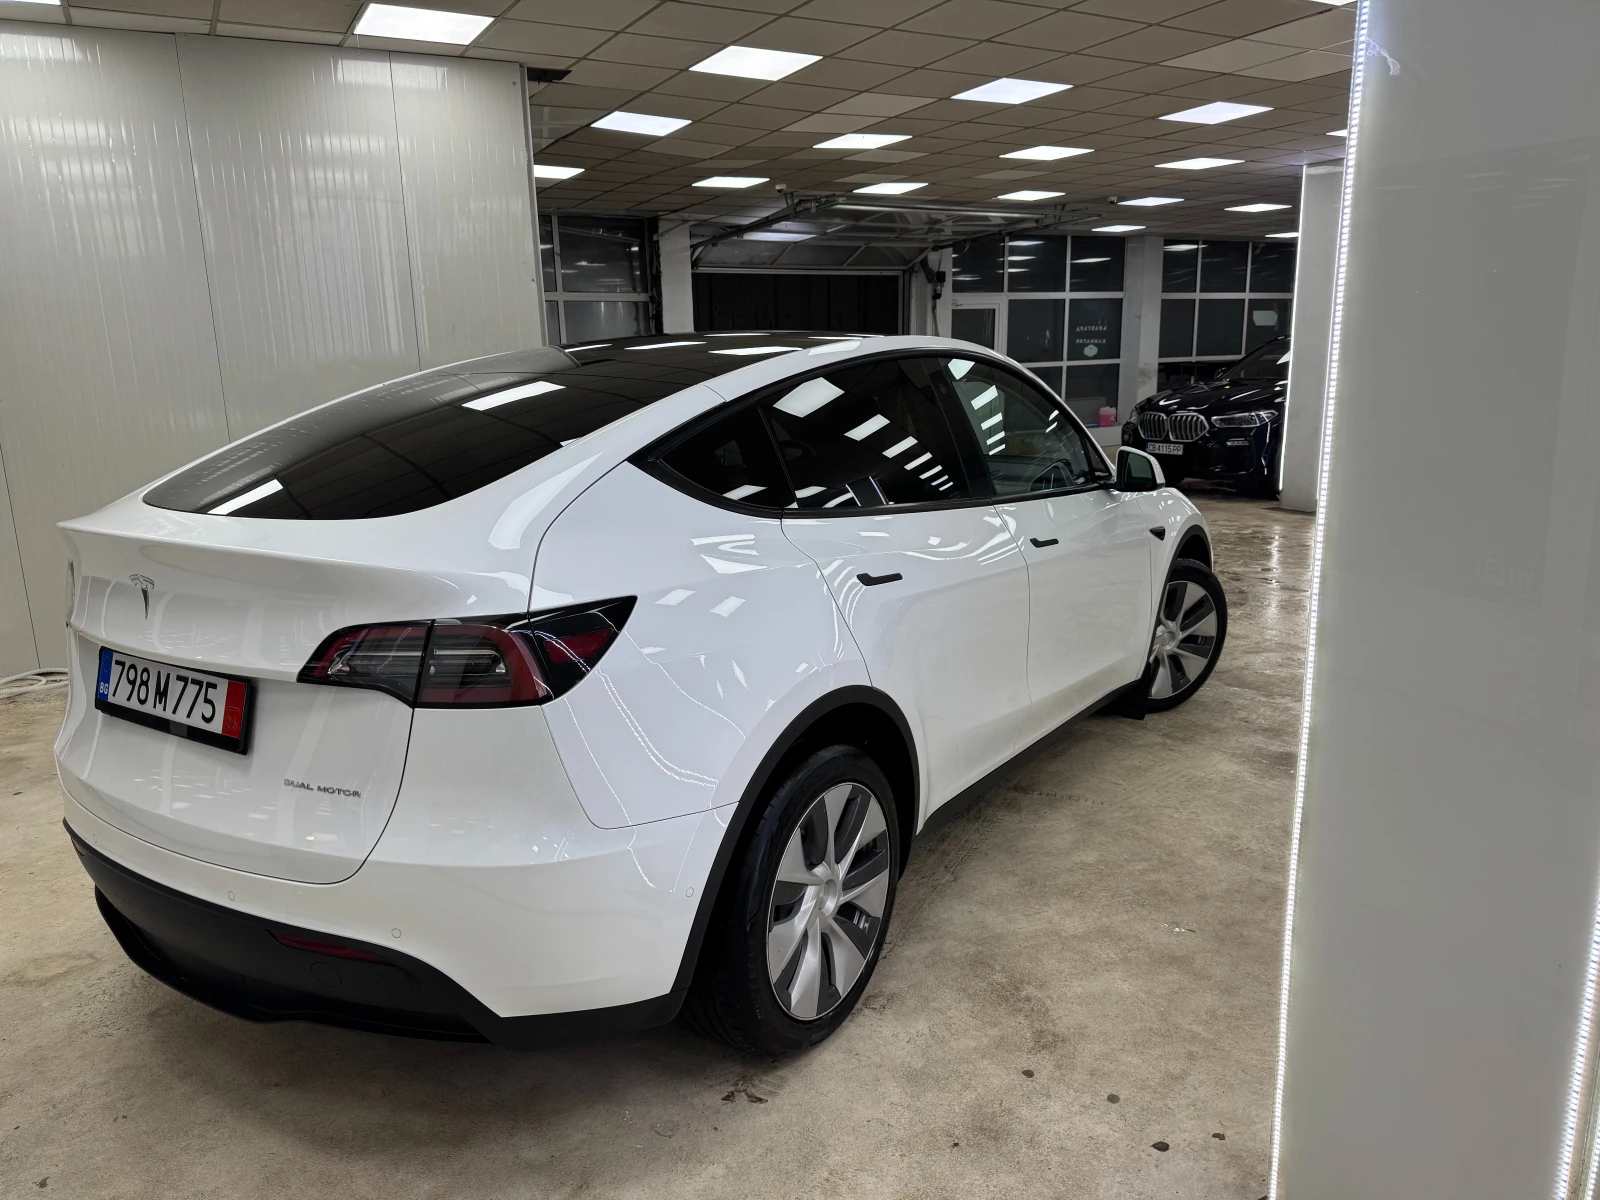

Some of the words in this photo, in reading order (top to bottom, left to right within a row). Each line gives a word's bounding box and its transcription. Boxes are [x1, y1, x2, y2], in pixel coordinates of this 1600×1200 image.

[99, 681, 108, 695] BG
[284, 778, 314, 791] DUAL
[317, 785, 362, 798] MOTOR
